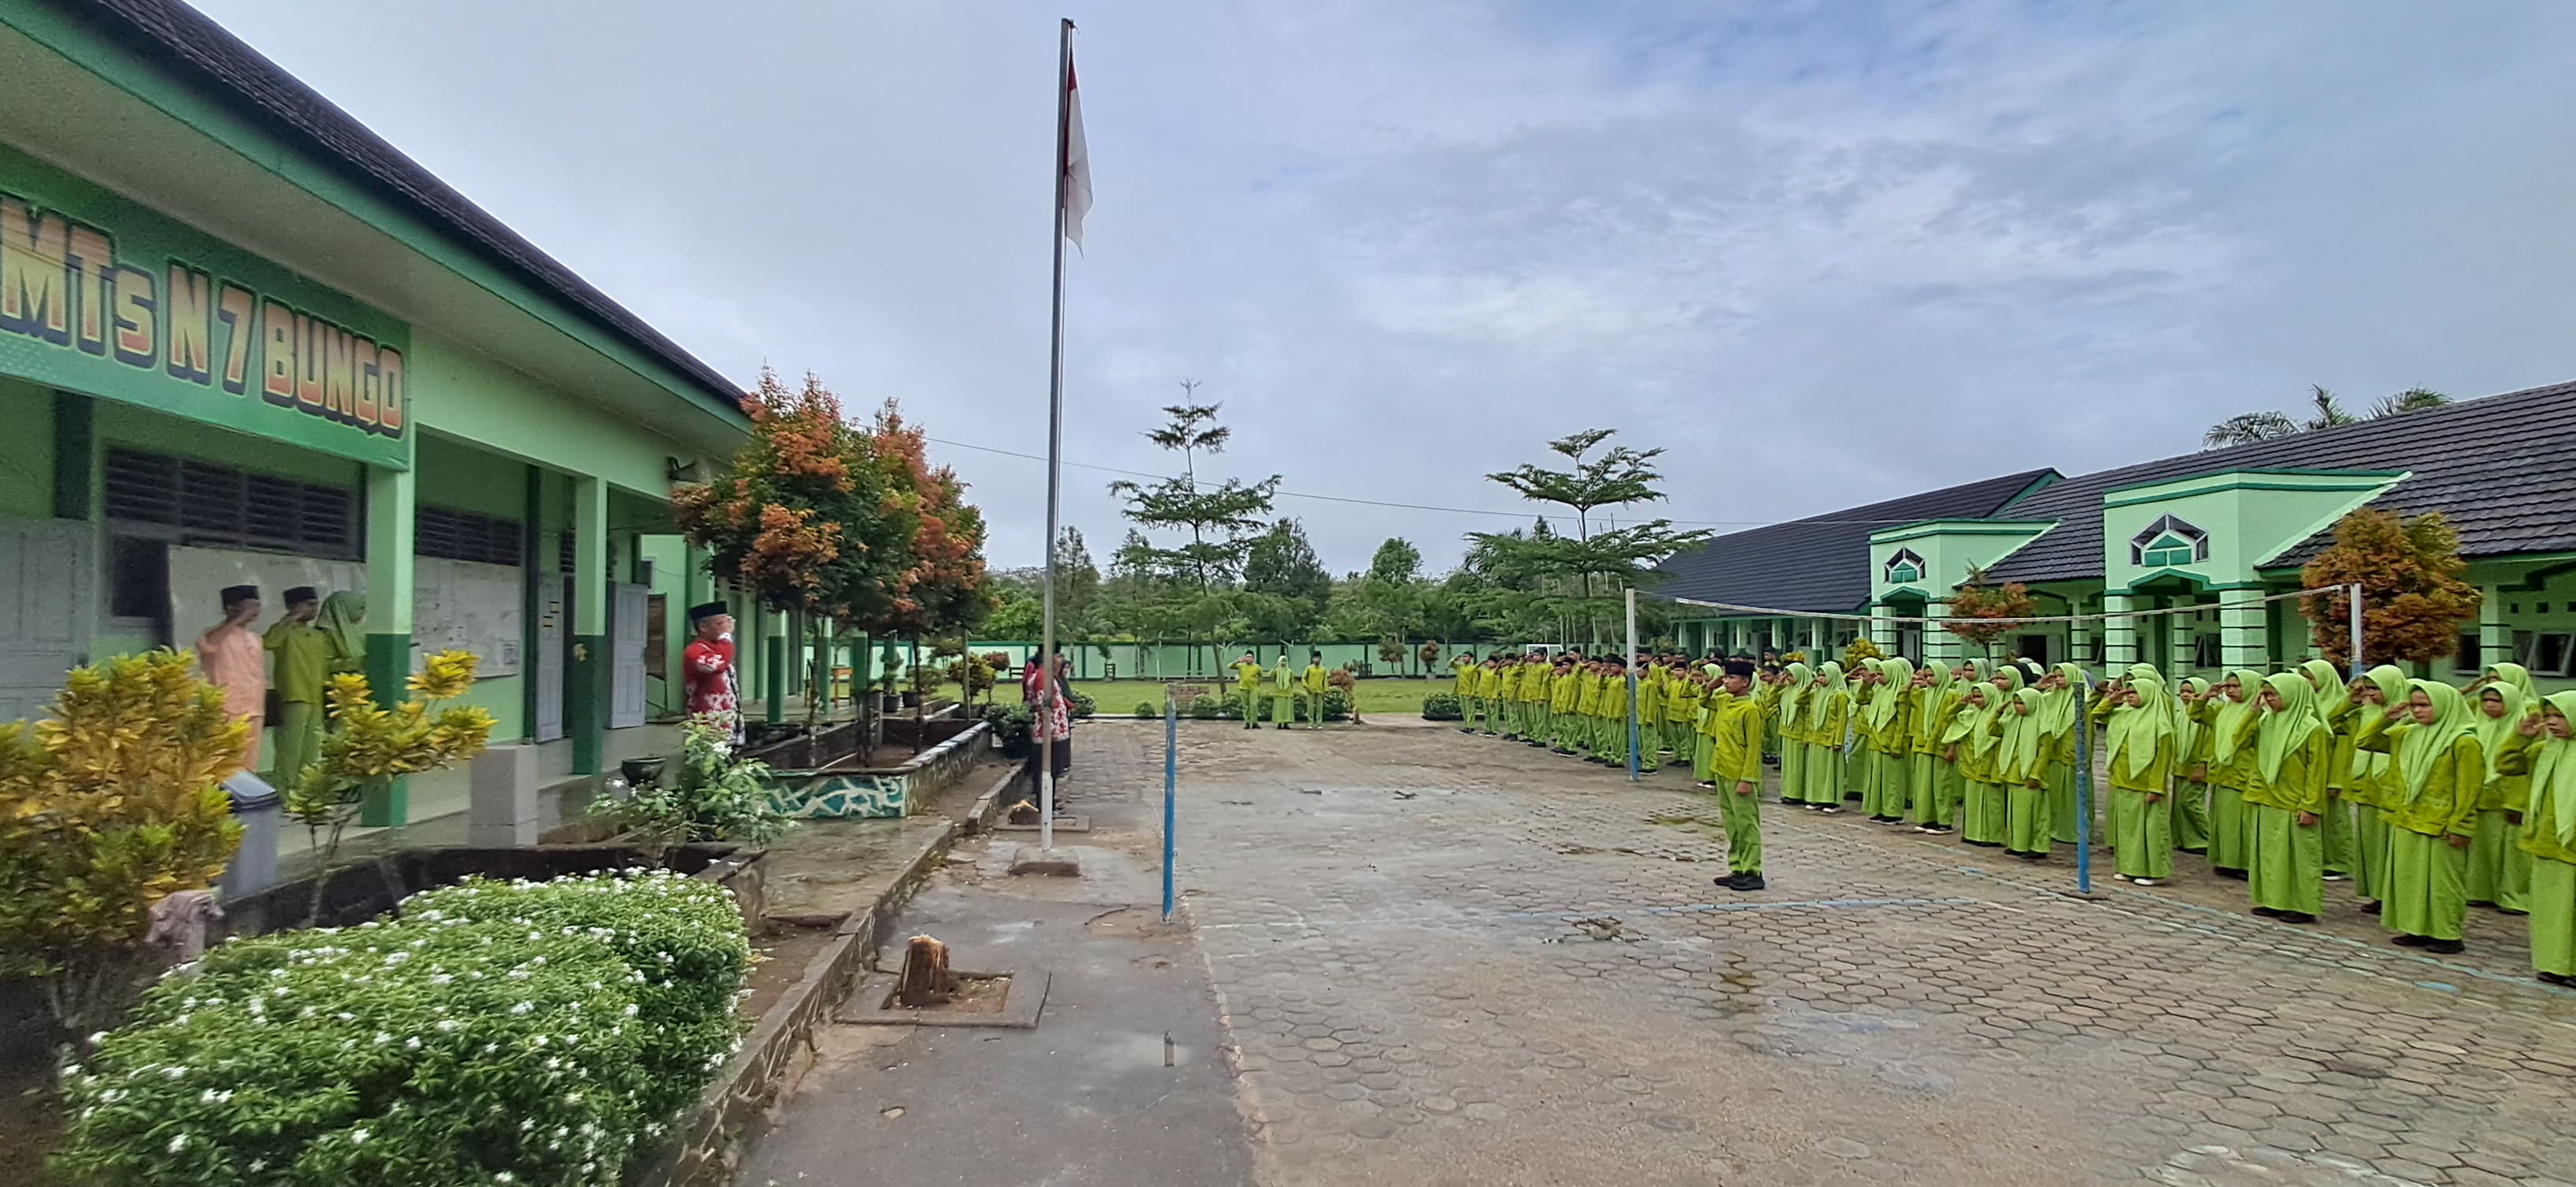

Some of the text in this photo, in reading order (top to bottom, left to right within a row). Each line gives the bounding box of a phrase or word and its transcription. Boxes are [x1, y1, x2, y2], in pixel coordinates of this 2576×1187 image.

[167, 263, 210, 377] N
[219, 283, 254, 389] 7
[264, 298, 402, 435] BUNGO
